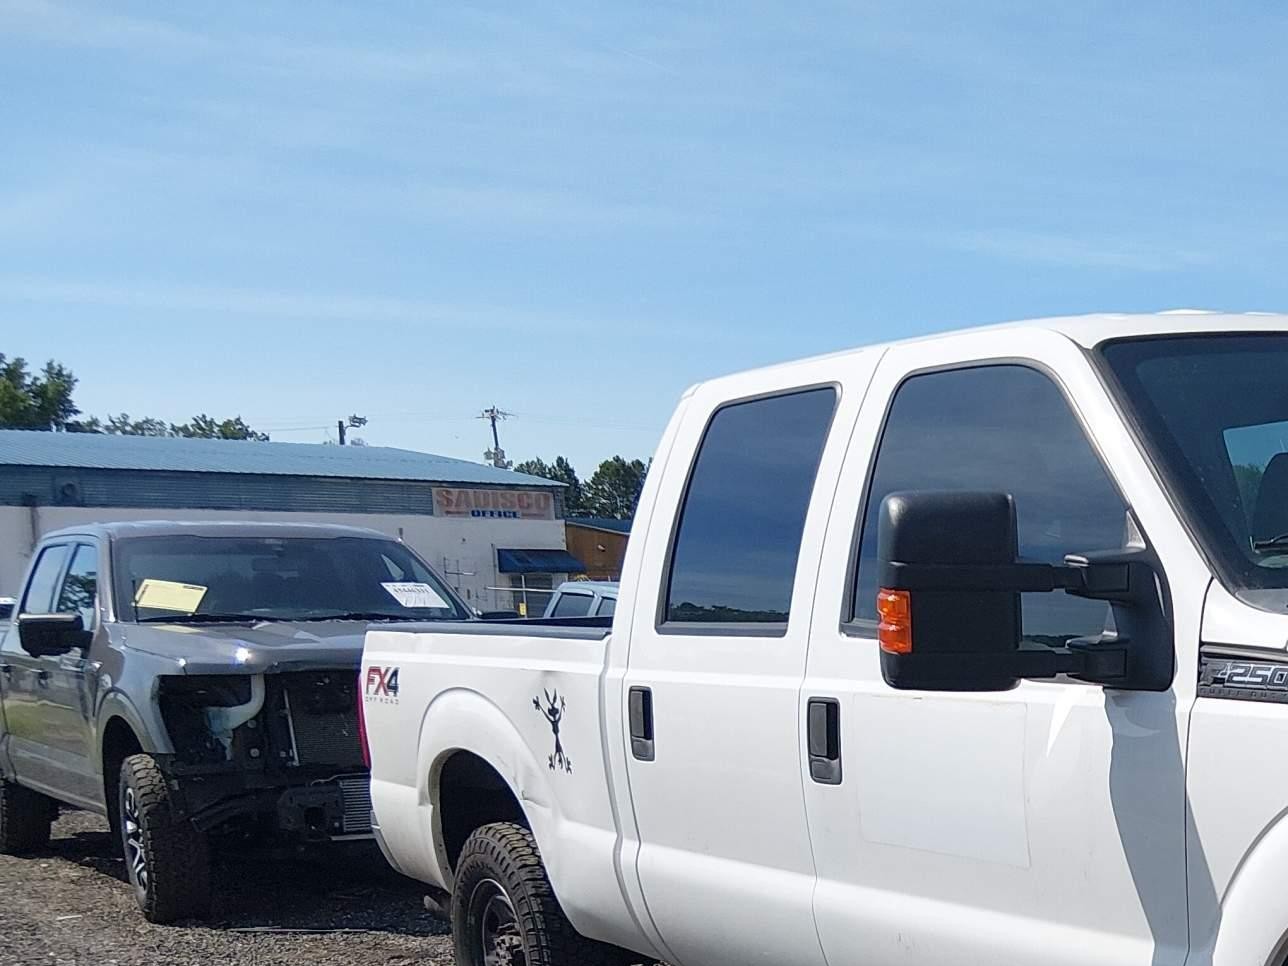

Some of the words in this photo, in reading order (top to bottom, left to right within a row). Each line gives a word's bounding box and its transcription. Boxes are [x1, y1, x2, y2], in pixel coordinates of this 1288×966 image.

[436, 489, 551, 510] SADISCO
[471, 509, 520, 519] OFFICE
[366, 666, 400, 697] FX4
